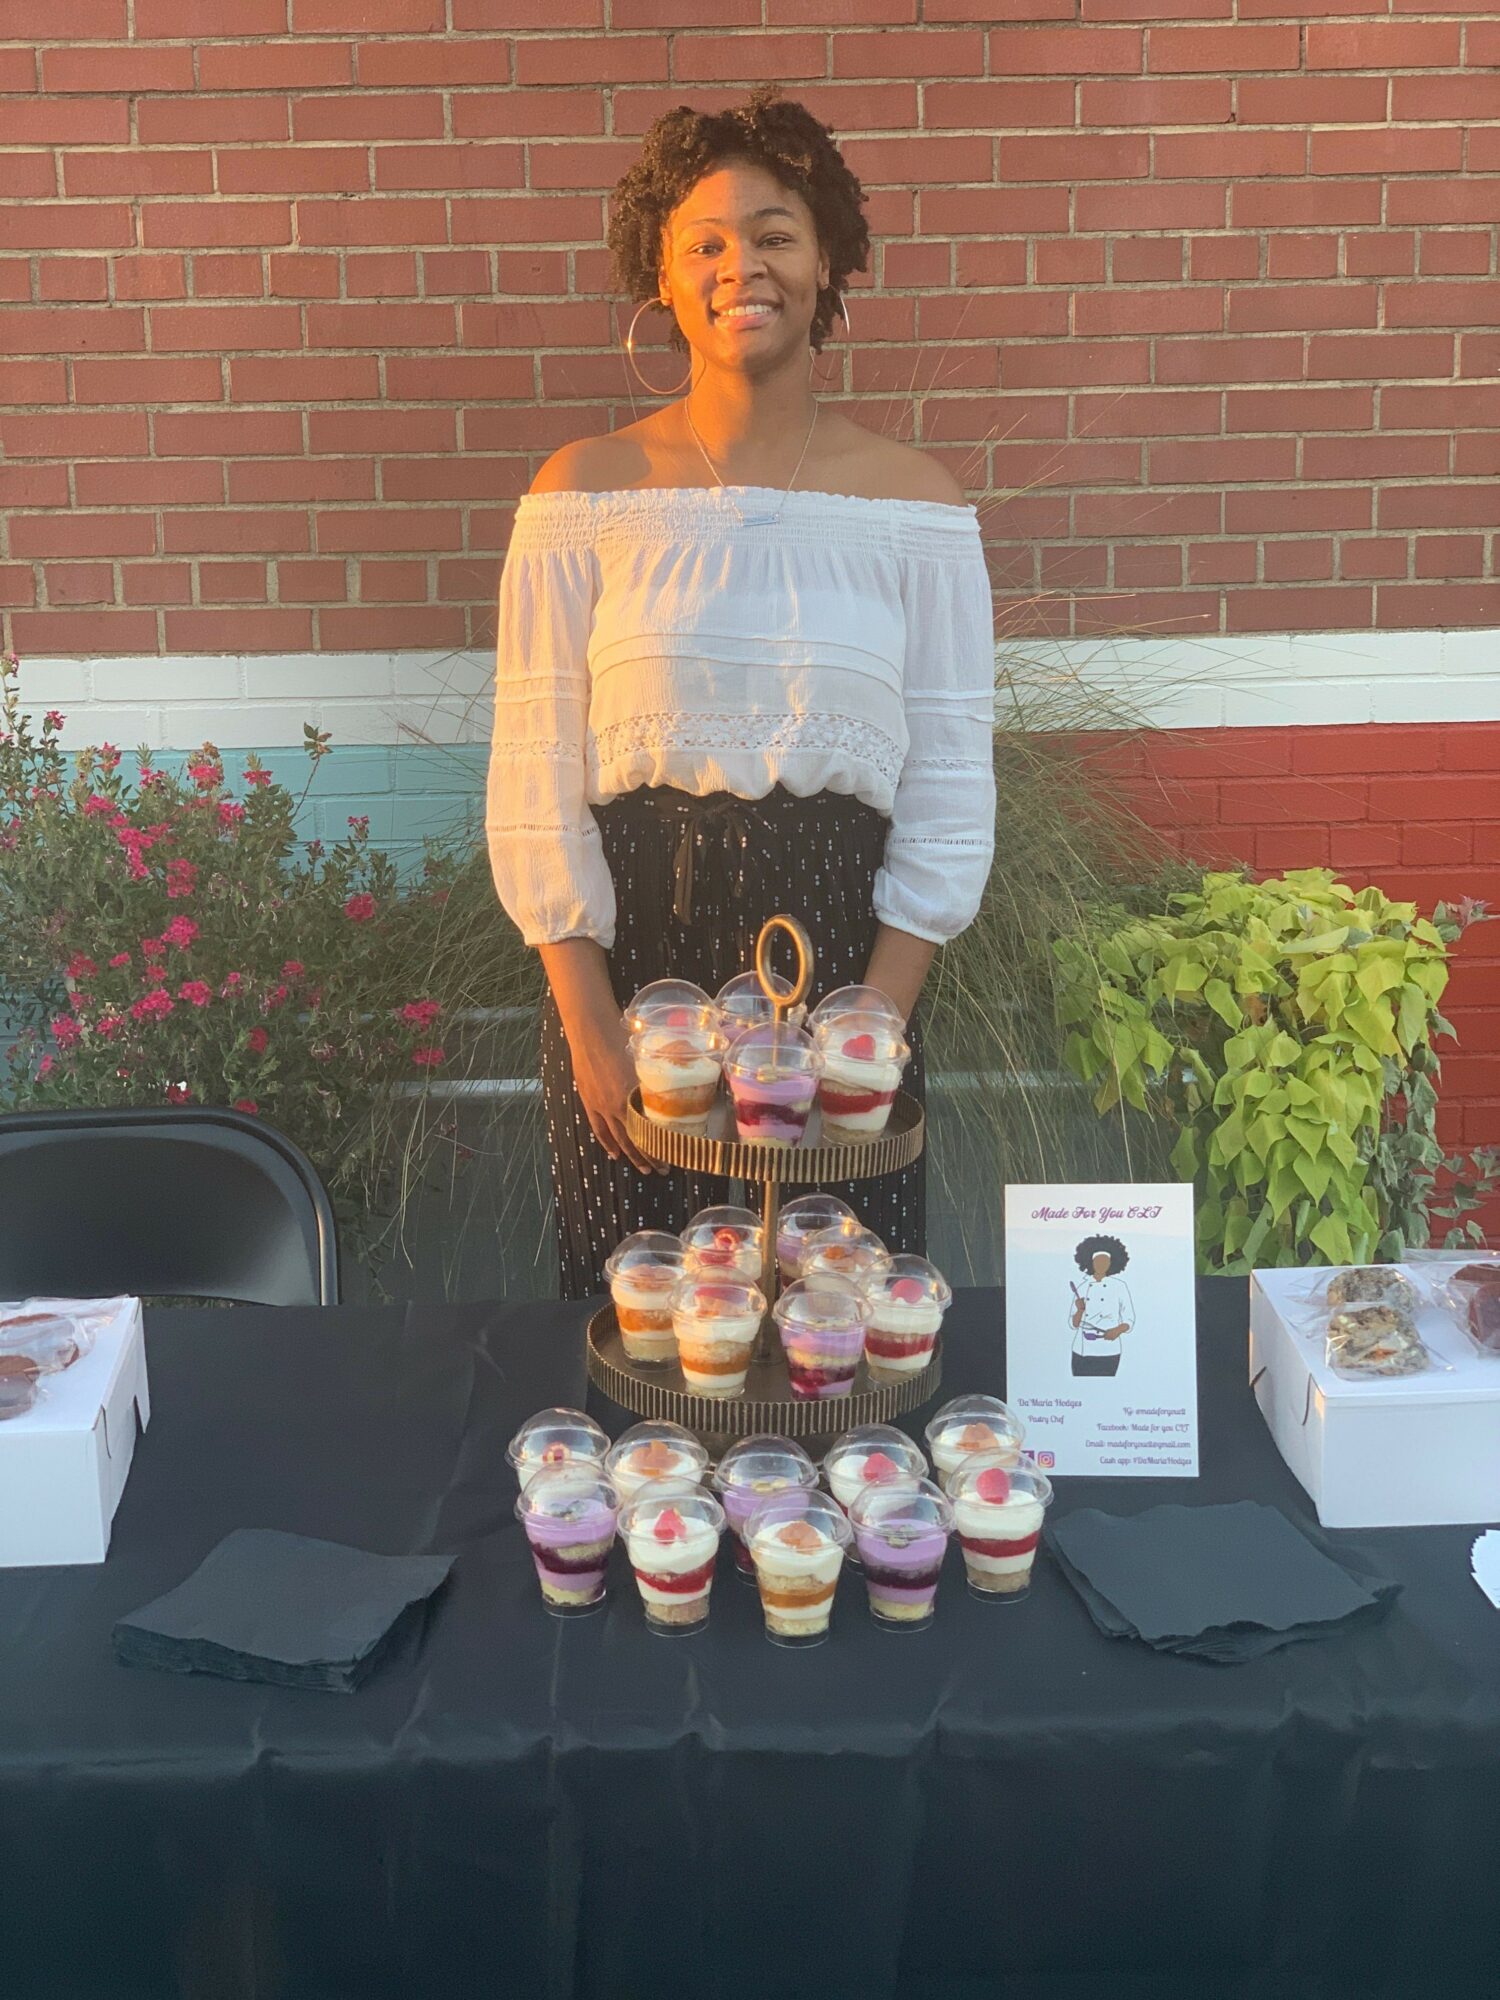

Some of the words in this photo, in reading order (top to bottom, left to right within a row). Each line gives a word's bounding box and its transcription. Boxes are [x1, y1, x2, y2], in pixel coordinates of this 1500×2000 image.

[1031, 1205, 1069, 1222] Made
[1071, 1205, 1096, 1220] For
[1098, 1206, 1124, 1224] You
[1054, 1398, 1082, 1409] Hodges
[1028, 1415, 1049, 1425] Pastry
[1050, 1415, 1064, 1425] Chef
[1097, 1423, 1128, 1432] Facebook:
[1131, 1423, 1149, 1432] Made
[1150, 1423, 1160, 1434] for
[1161, 1426, 1174, 1434] you
[1100, 1456, 1116, 1465] Cash
